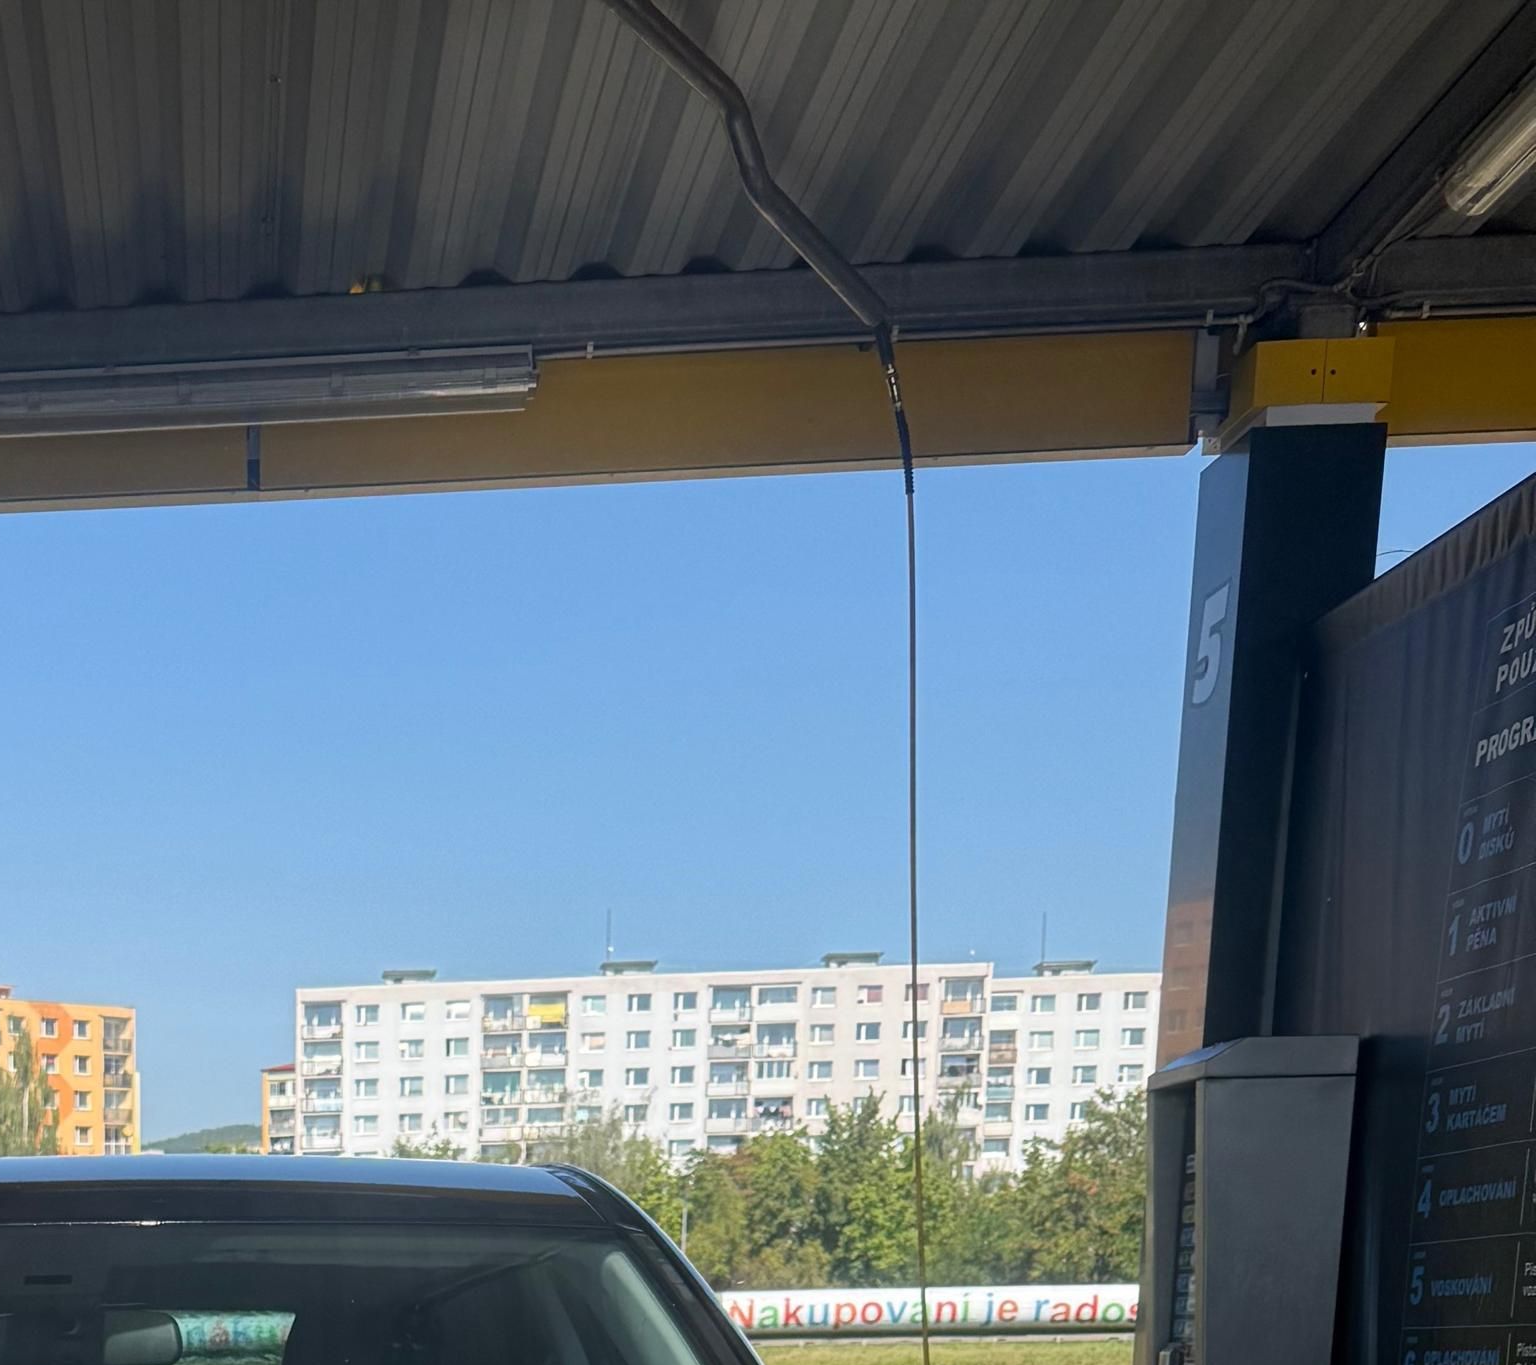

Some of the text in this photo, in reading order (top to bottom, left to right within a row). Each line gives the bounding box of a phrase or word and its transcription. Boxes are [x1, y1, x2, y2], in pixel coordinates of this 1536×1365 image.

[1191, 580, 1230, 704] 5
[1457, 821, 1474, 865] 0
[1448, 914, 1461, 957] 1
[1434, 1003, 1451, 1046] 2
[1455, 1018, 1485, 1044] MYTÍ
[1425, 1080, 1477, 1134] 3 MYTÍ
[1446, 1103, 1507, 1132] KARTÁČEM
[1417, 1176, 1517, 1219] 4 OPLACHOVÁNÍ
[1409, 1265, 1425, 1305] 5
[980, 1292, 1019, 1326] je
